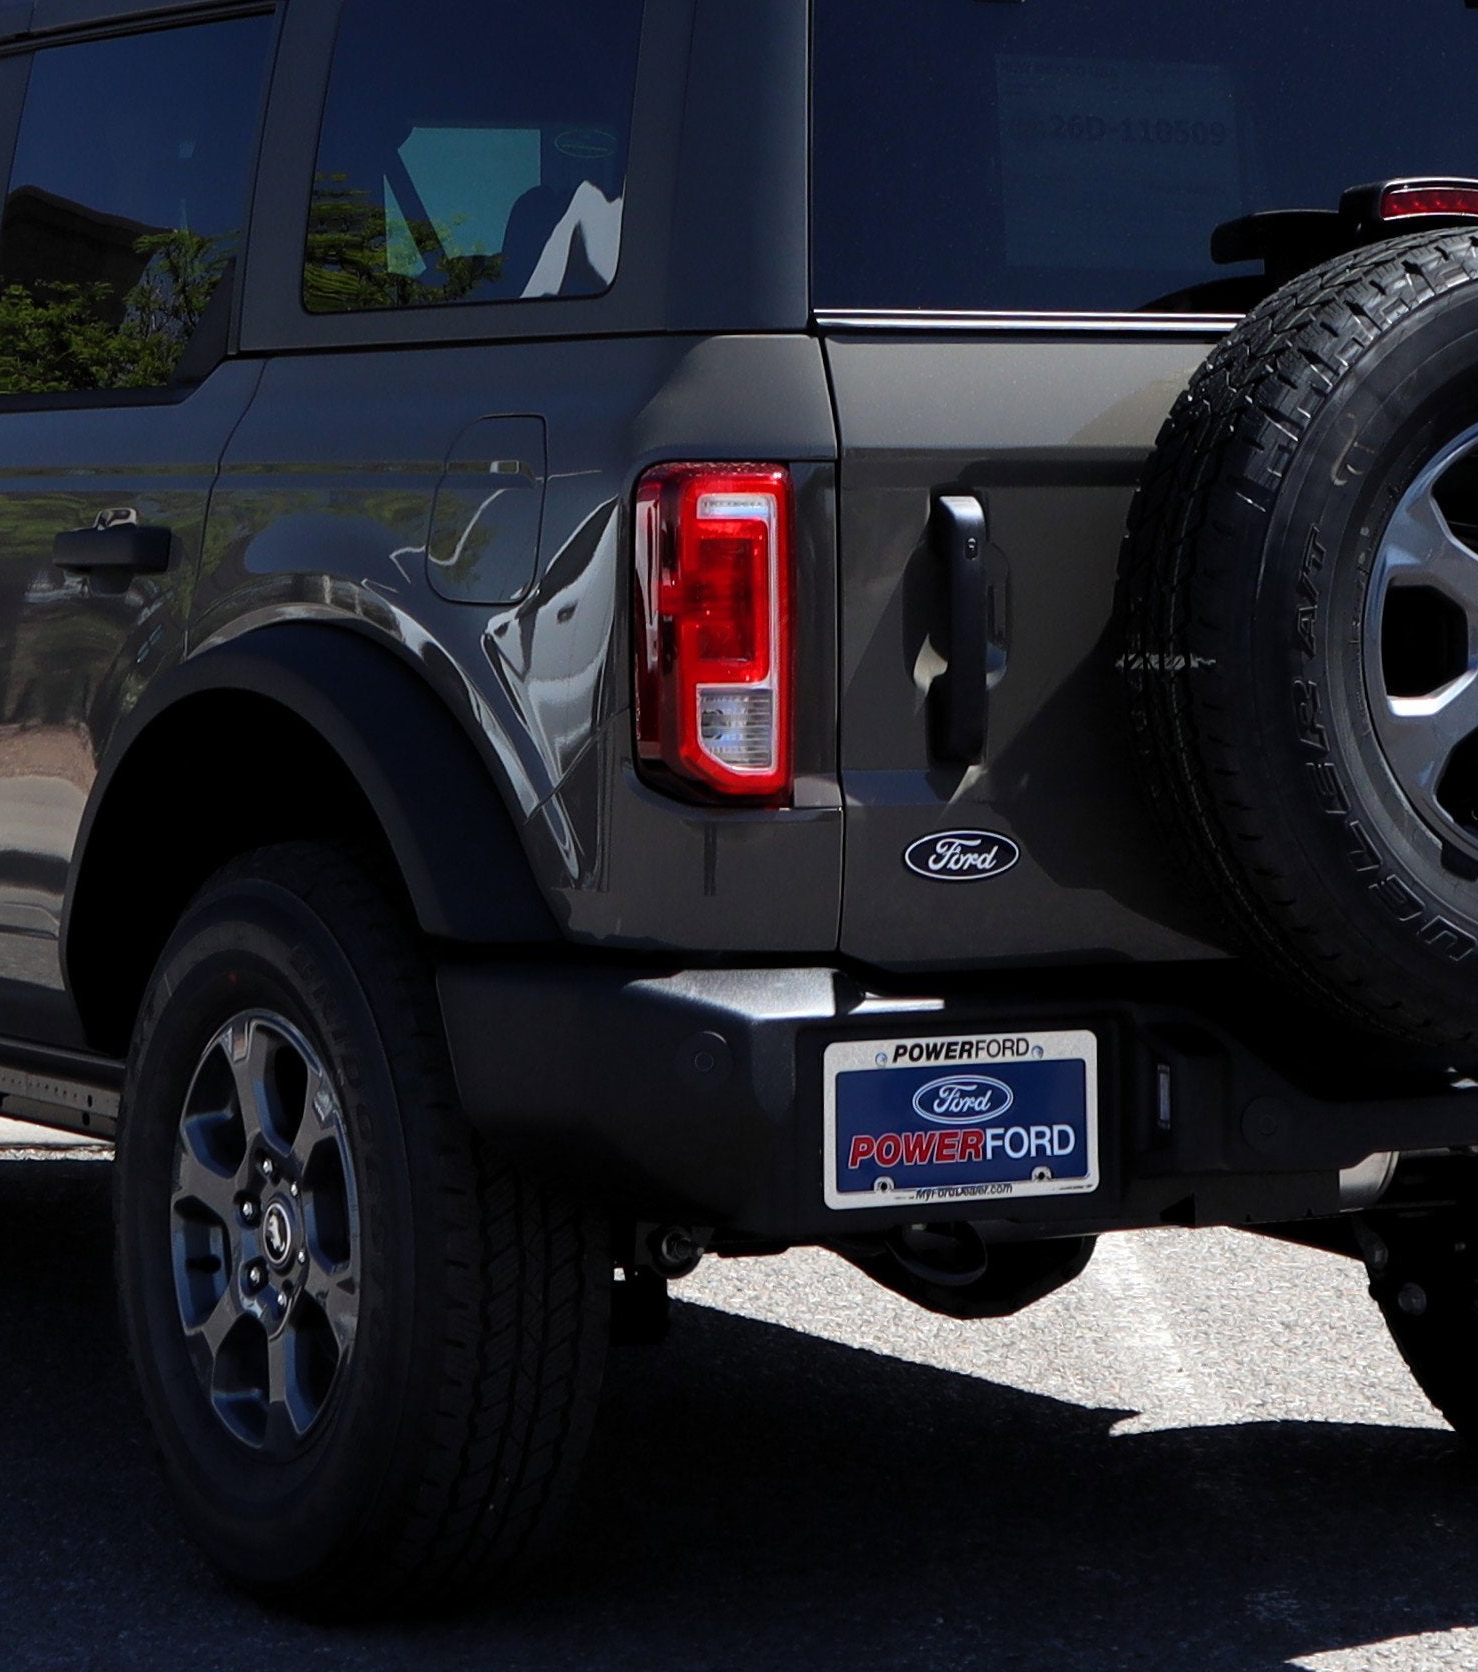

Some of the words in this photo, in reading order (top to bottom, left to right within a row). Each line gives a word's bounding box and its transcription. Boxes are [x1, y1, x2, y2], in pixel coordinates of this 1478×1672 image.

[927, 837, 1000, 872] Ford
[891, 1037, 1030, 1064] POWERFORD
[933, 1083, 992, 1114] Ford
[848, 1123, 1076, 1170] POWERFORD
